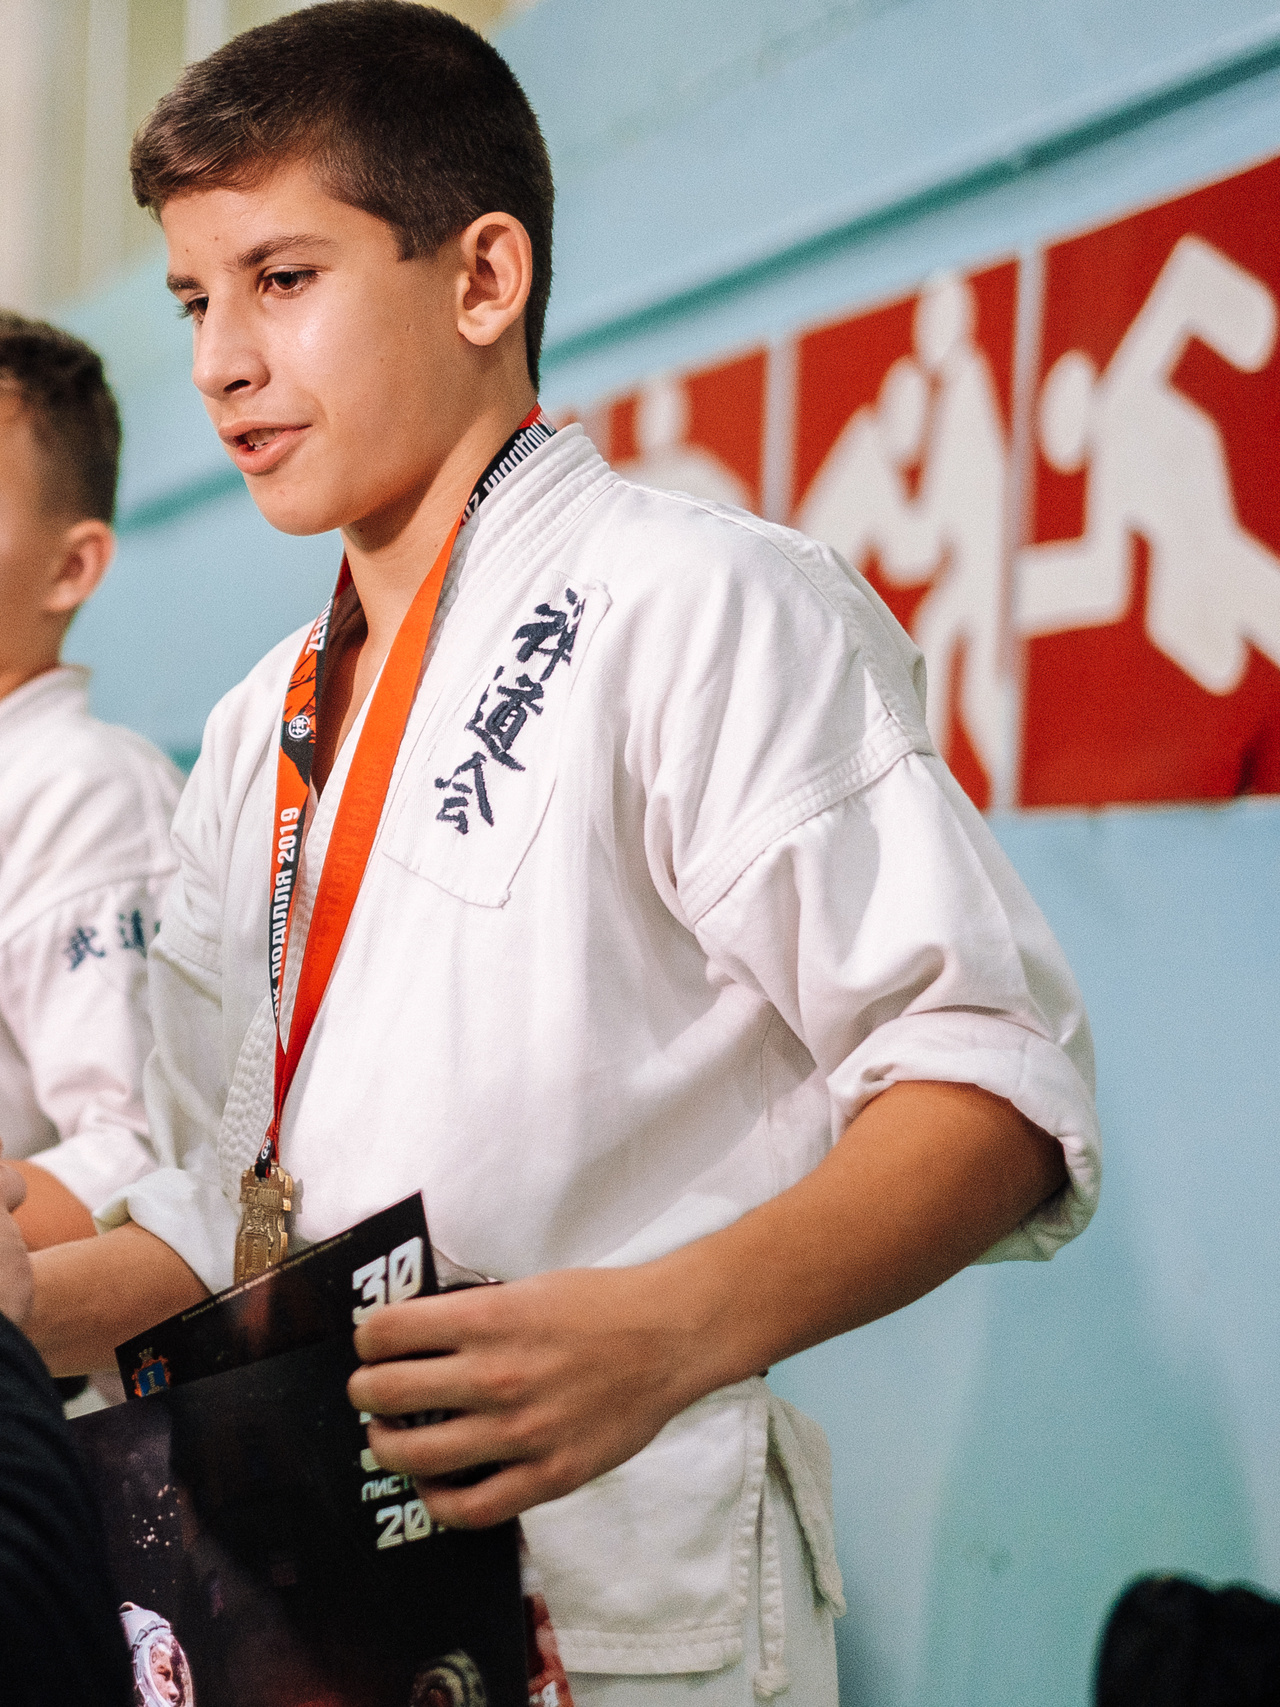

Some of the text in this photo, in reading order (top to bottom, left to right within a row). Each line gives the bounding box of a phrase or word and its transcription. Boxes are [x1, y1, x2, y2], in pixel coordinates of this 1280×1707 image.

[277, 807, 299, 864] 2019
[272, 869, 292, 979] ПОДІЛЛЯ
[352, 1236, 423, 1325] 30
[376, 1499, 445, 1550] 20
